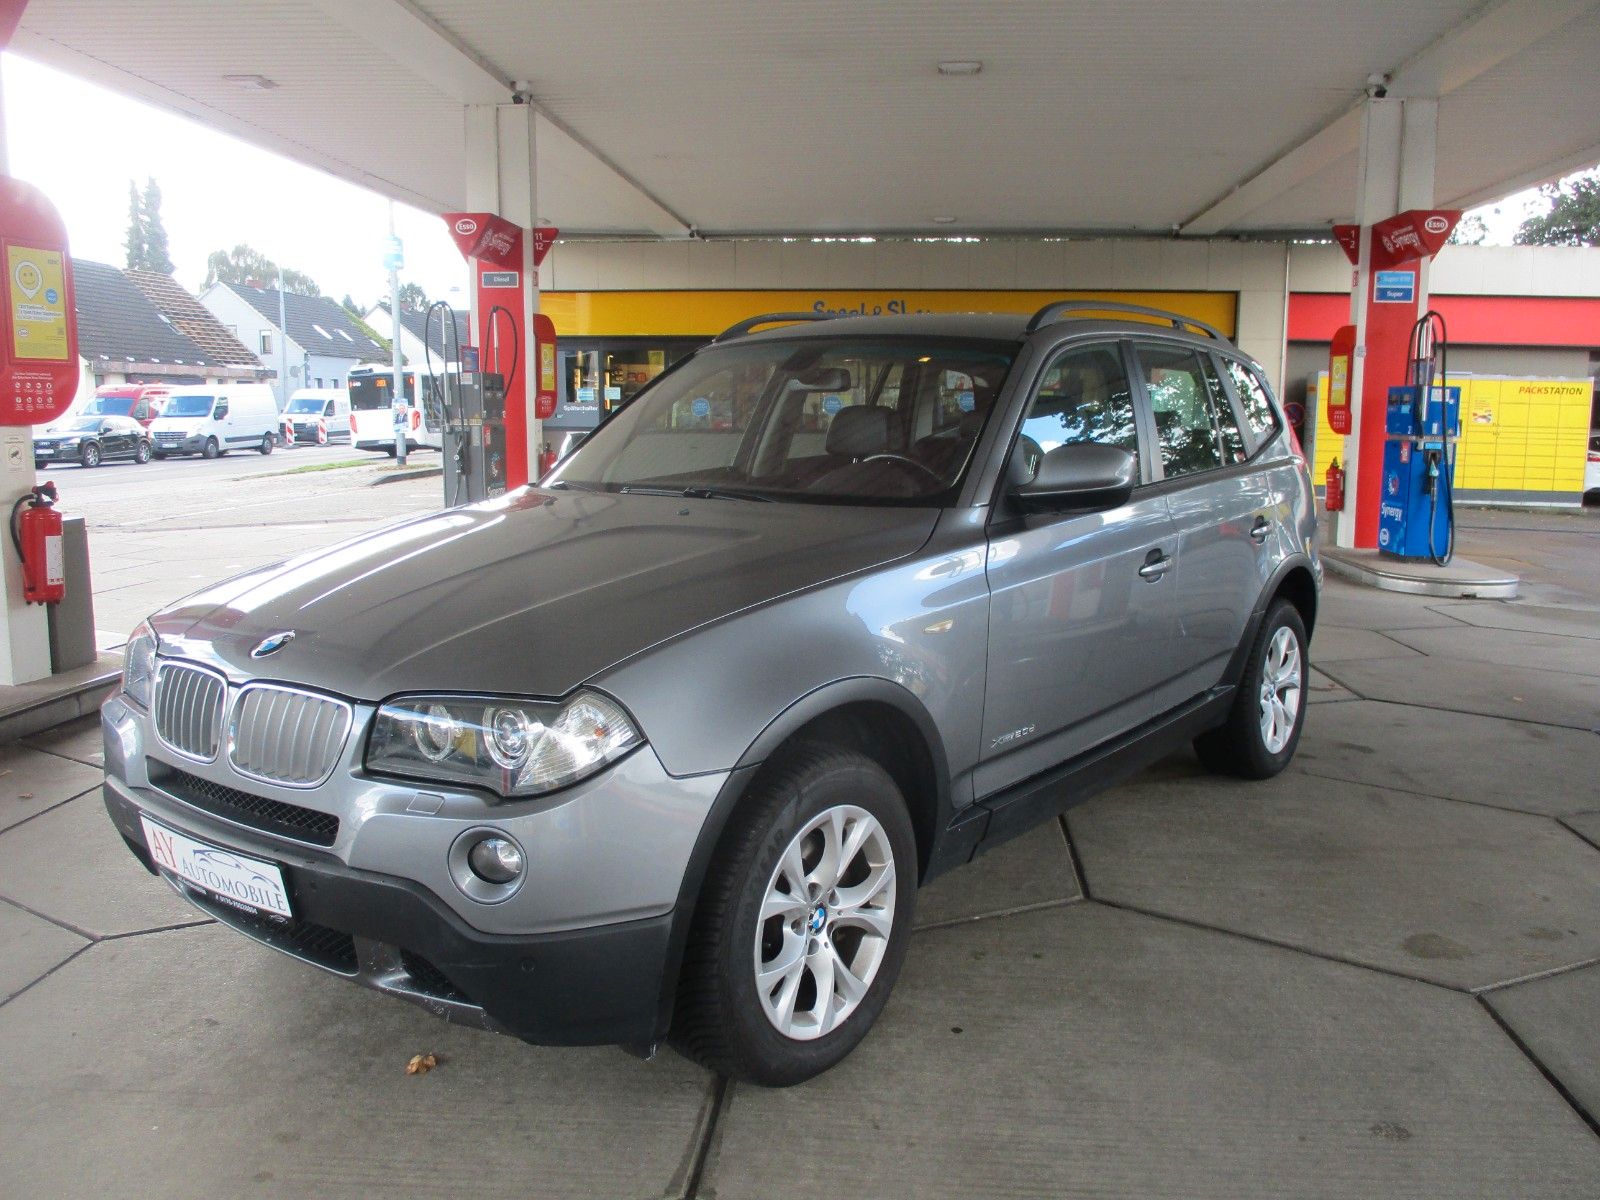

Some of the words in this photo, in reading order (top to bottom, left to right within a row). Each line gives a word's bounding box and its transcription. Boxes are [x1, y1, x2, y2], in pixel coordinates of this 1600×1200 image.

[458, 222, 474, 230] Esso
[1428, 220, 1445, 228] Esso
[535, 232, 543, 240] 11
[1387, 291, 1404, 299] Super
[1519, 386, 1583, 395] PACKSTATION
[151, 829, 178, 869] AY
[182, 858, 287, 912] AUTOMOBILE
